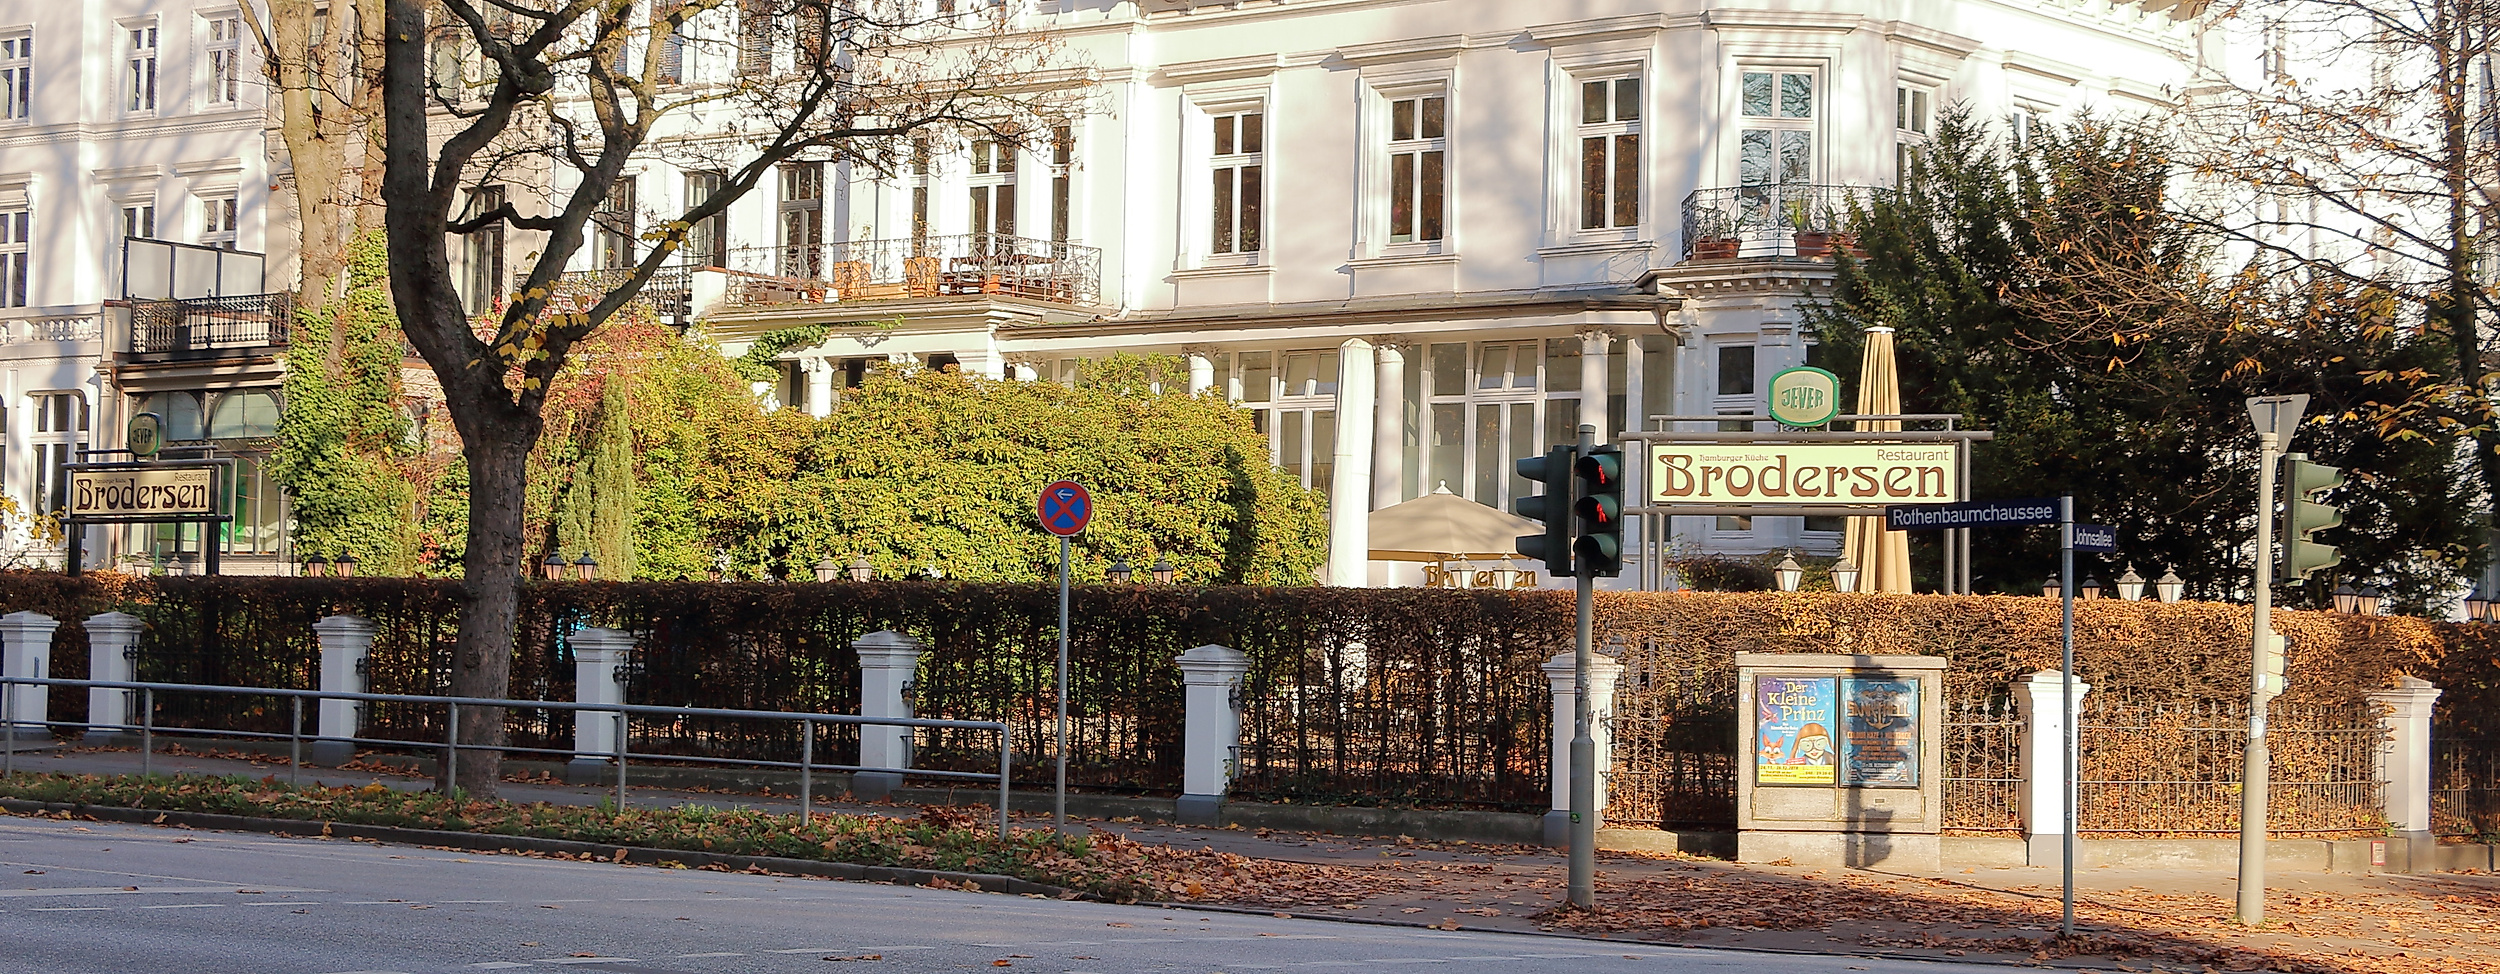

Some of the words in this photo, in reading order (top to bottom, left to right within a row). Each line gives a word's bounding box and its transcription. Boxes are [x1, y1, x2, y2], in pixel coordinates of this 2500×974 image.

[1781, 386, 1824, 409] JEVER
[1876, 449, 1949, 462] Restaurant
[174, 472, 208, 483] Restaurant
[1658, 454, 1948, 498] Brodersen
[76, 478, 206, 510] Brodersen
[1892, 504, 2053, 526] Rothenbaumchaussee
[2074, 527, 2112, 547] Johnsallee
[1785, 682, 1808, 693] Der
[1767, 692, 1817, 706] Kleine
[1780, 706, 1826, 721] Prinz
